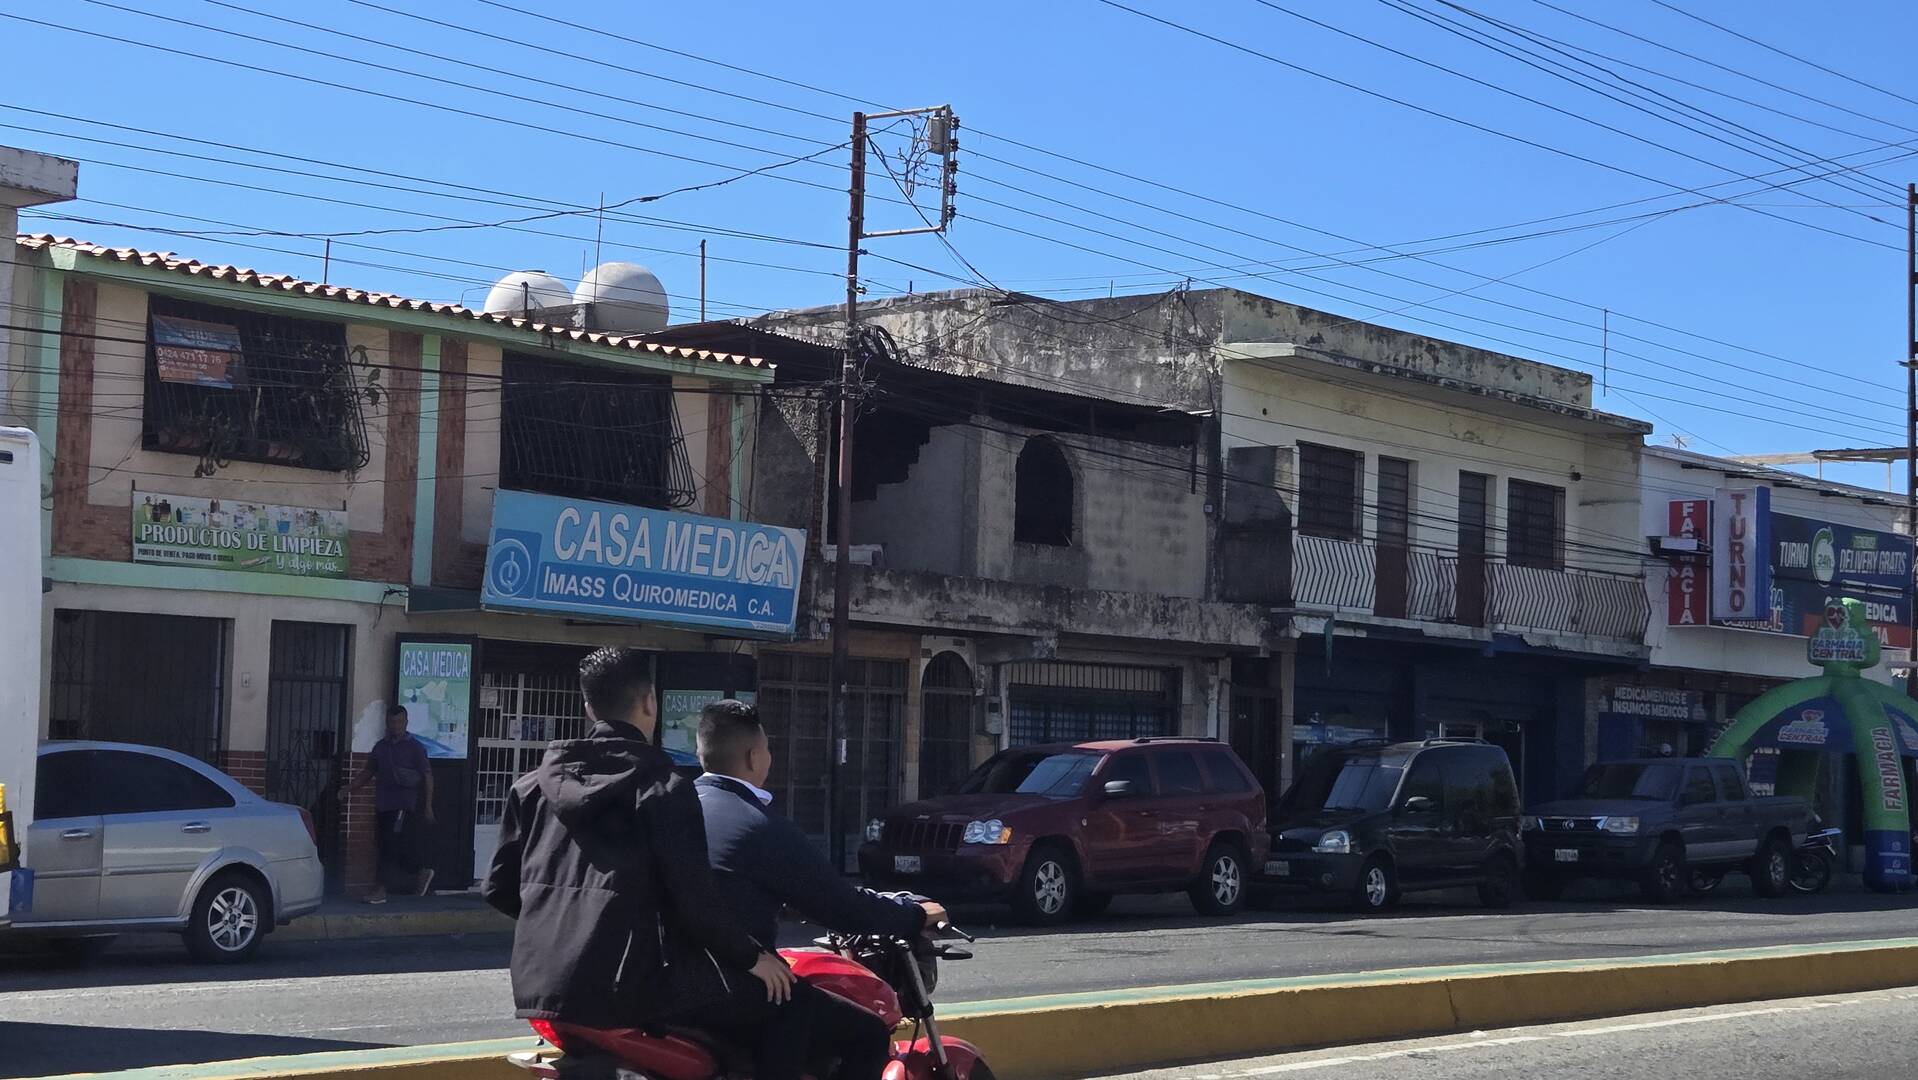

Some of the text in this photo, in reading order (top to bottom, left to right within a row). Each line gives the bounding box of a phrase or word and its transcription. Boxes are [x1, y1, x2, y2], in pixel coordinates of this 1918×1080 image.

[140, 523, 344, 557] PRODUCTOS DE LIMPIEZA
[553, 506, 792, 587] CASA MEDICA
[1729, 493, 1746, 612] TURNO
[277, 554, 285, 570] Y
[289, 558, 312, 575] algo
[1780, 541, 1809, 568] TURNO
[1840, 548, 1907, 576] DELIVERY GRATIS
[543, 565, 775, 617] IMASS QUIROMEDICA C.A.
[1865, 602, 1898, 623] EDICA
[1812, 639, 1864, 651] FARMACIA
[1812, 648, 1864, 660] CENTRAL
[403, 650, 469, 678] CASA MEDICA
[665, 694, 688, 713] CASA
[1612, 700, 1689, 718] INSUMOS MEDICOS
[1614, 687, 1688, 705] MEDICAMENTOS E
[1871, 727, 1903, 811] FARMACIA
